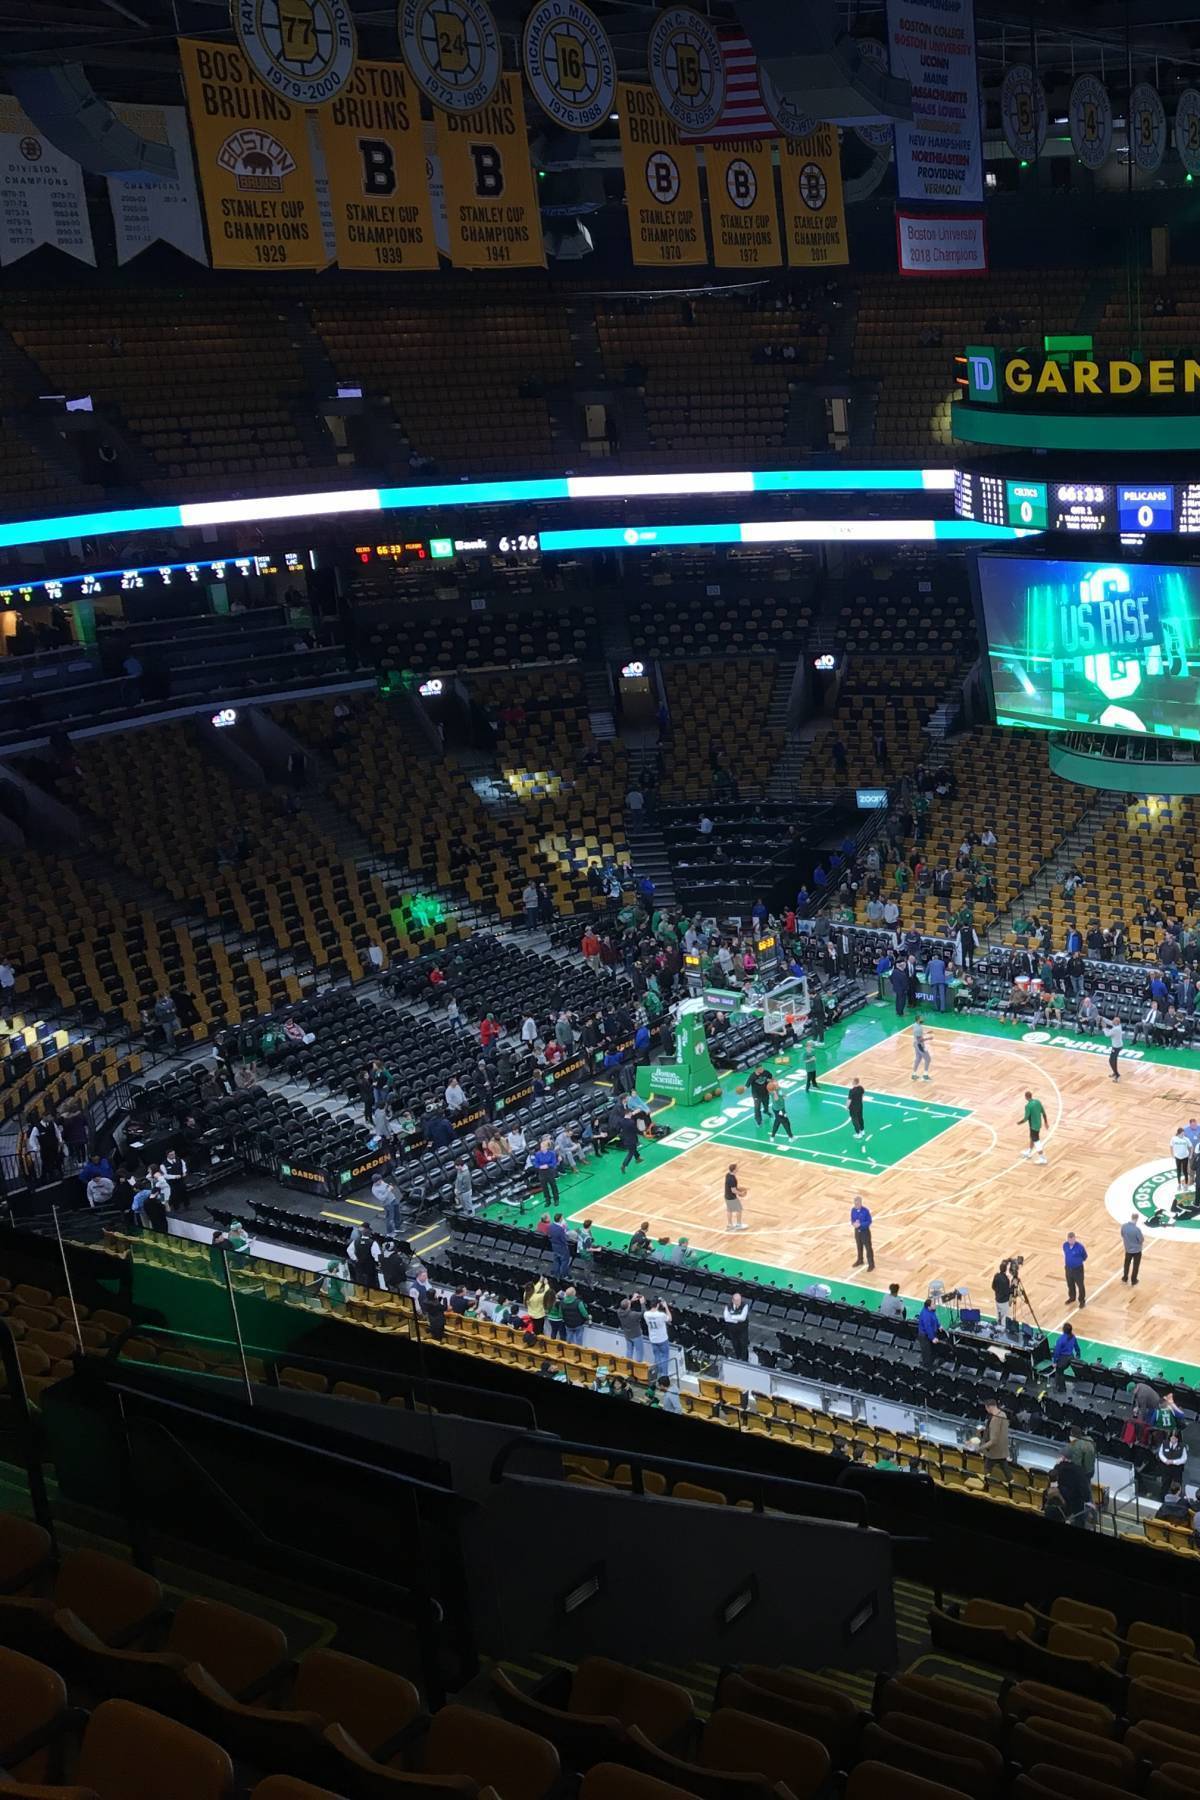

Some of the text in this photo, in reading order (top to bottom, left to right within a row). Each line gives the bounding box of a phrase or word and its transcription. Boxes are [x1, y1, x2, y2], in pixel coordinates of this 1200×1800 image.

[282, 16, 312, 45] 77
[900, 18, 931, 34] BOSTON
[440, 32, 465, 55] 24
[528, 4, 613, 87] RICHARD MIDDLETON
[653, 15, 722, 74] MILTON SCHMIDT
[561, 47, 581, 79] 16
[680, 56, 698, 86] 15
[266, 66, 341, 99] 1979-2000
[203, 83, 291, 121] BRUINS
[332, 97, 410, 132] BRUINS
[549, 98, 602, 124] 1976-1988
[1020, 101, 1030, 127] 5
[1087, 111, 1096, 134] 4
[1143, 118, 1151, 140] 3
[629, 117, 680, 145] BRUIN
[1190, 122, 1199, 144] 2
[909, 134, 972, 150] NEW HAMPSHIRE
[219, 131, 293, 171] BOSTON
[912, 150, 970, 166] NORTHEASTERN
[9, 164, 58, 174] DIVISION
[359, 139, 396, 194] B
[470, 145, 504, 196] B
[918, 167, 966, 180] PROVIDENCE
[5, 176, 69, 186] CHAMPIONS
[239, 176, 280, 190] BRUINS
[655, 163, 672, 192] B
[735, 170, 750, 198] B
[806, 174, 820, 200] B
[924, 183, 961, 195] VERMONT
[221, 199, 305, 219] STANLEY CUP
[346, 204, 419, 223] STANLEY CUP
[460, 206, 525, 222] STANLEY CUP
[639, 209, 693, 225] STANLEY CUP
[721, 214, 770, 229] STANLEY CUP
[794, 215, 837, 230] STANLEY CUP
[223, 221, 309, 241] CHAMPIONS
[348, 225, 423, 243] CHAMPIONS
[461, 226, 529, 242] CHAMPIONS
[641, 228, 696, 242] CHAMPIONS
[722, 232, 772, 246] CHAMPIONS
[794, 231, 840, 245] CHAMPIONS
[908, 226, 977, 242] Boston University
[255, 245, 287, 263] 1929
[376, 247, 403, 264] 1939
[486, 246, 510, 261] 1941
[661, 246, 681, 260] 1970
[740, 248, 758, 262] 1972
[812, 248, 828, 261] 2011
[910, 248, 978, 264] 2018 Champions
[969, 356, 994, 391] TD
[1014, 488, 1037, 498] CELTICS
[1058, 486, 1104, 502] 66:33
[1124, 491, 1166, 501] PELICANS
[1021, 502, 1032, 523] 0
[1137, 506, 1154, 528] 0
[377, 545, 401, 555] 66:33
[455, 535, 538, 551] Bank 6:26
[361, 554, 368, 563] 0
[418, 549, 425, 558] 0
[81, 582, 101, 594] 3/4
[121, 578, 143, 589] 2/2
[163, 575, 171, 584] 1
[190, 572, 198, 582] 1
[216, 569, 224, 578] 3
[241, 566, 249, 576] 1
[1061, 596, 1154, 651] US RISE
[629, 661, 644, 673] 10
[820, 654, 834, 666] 10
[427, 679, 443, 691] 10
[219, 709, 236, 721] 10
[758, 938, 775, 951] 66:33
[1050, 1035, 1145, 1059] Putnam
[554, 1058, 586, 1079] GARDEN
[352, 1154, 391, 1177] GARDEN
[291, 1169, 325, 1183] GARDEN
[1136, 1170, 1177, 1208] BOSTON
[649, 1321, 658, 1329] 11
